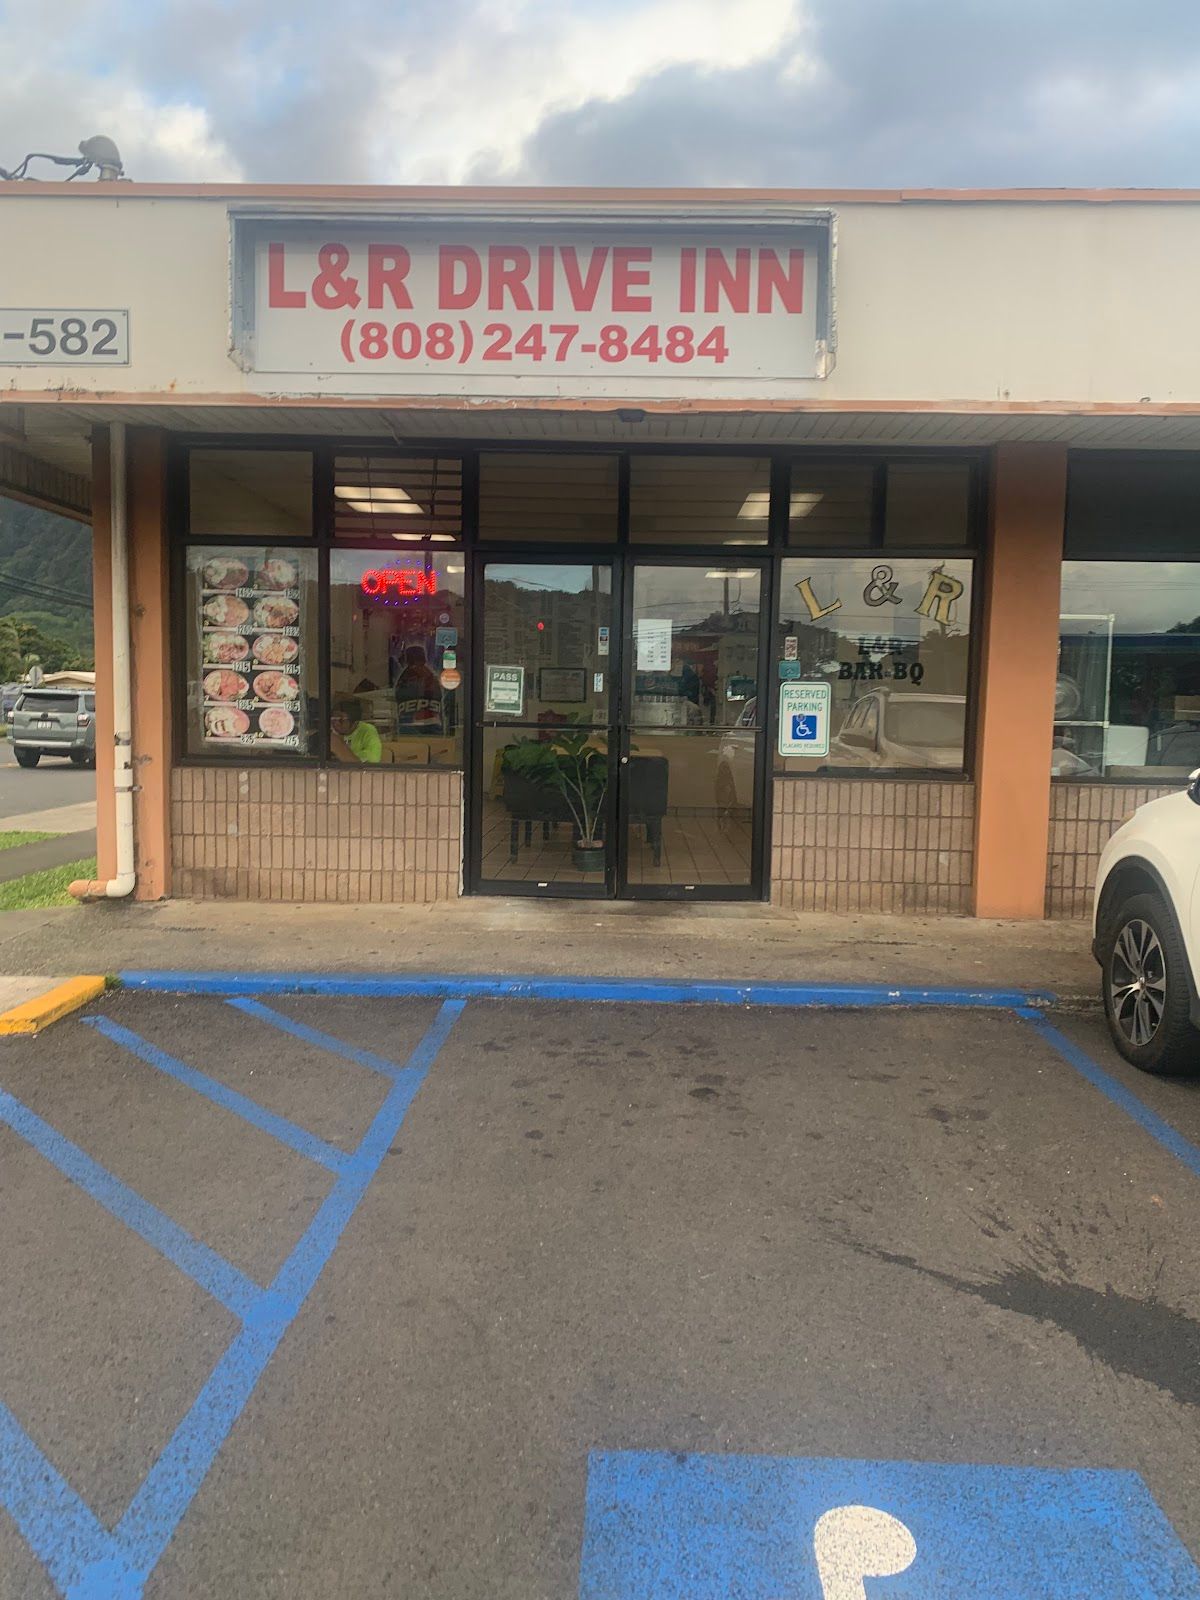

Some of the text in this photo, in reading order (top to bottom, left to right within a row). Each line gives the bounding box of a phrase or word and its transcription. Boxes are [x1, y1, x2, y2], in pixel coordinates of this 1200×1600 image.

[268, 242, 805, 315] L&R DRIVE INN
[361, 569, 439, 595] OPEN
[794, 564, 964, 626] L & R
[493, 672, 518, 682] PASS
[784, 689, 828, 699] RESERVED
[398, 698, 442, 715] PEPSI
[787, 702, 823, 712] PARKING
